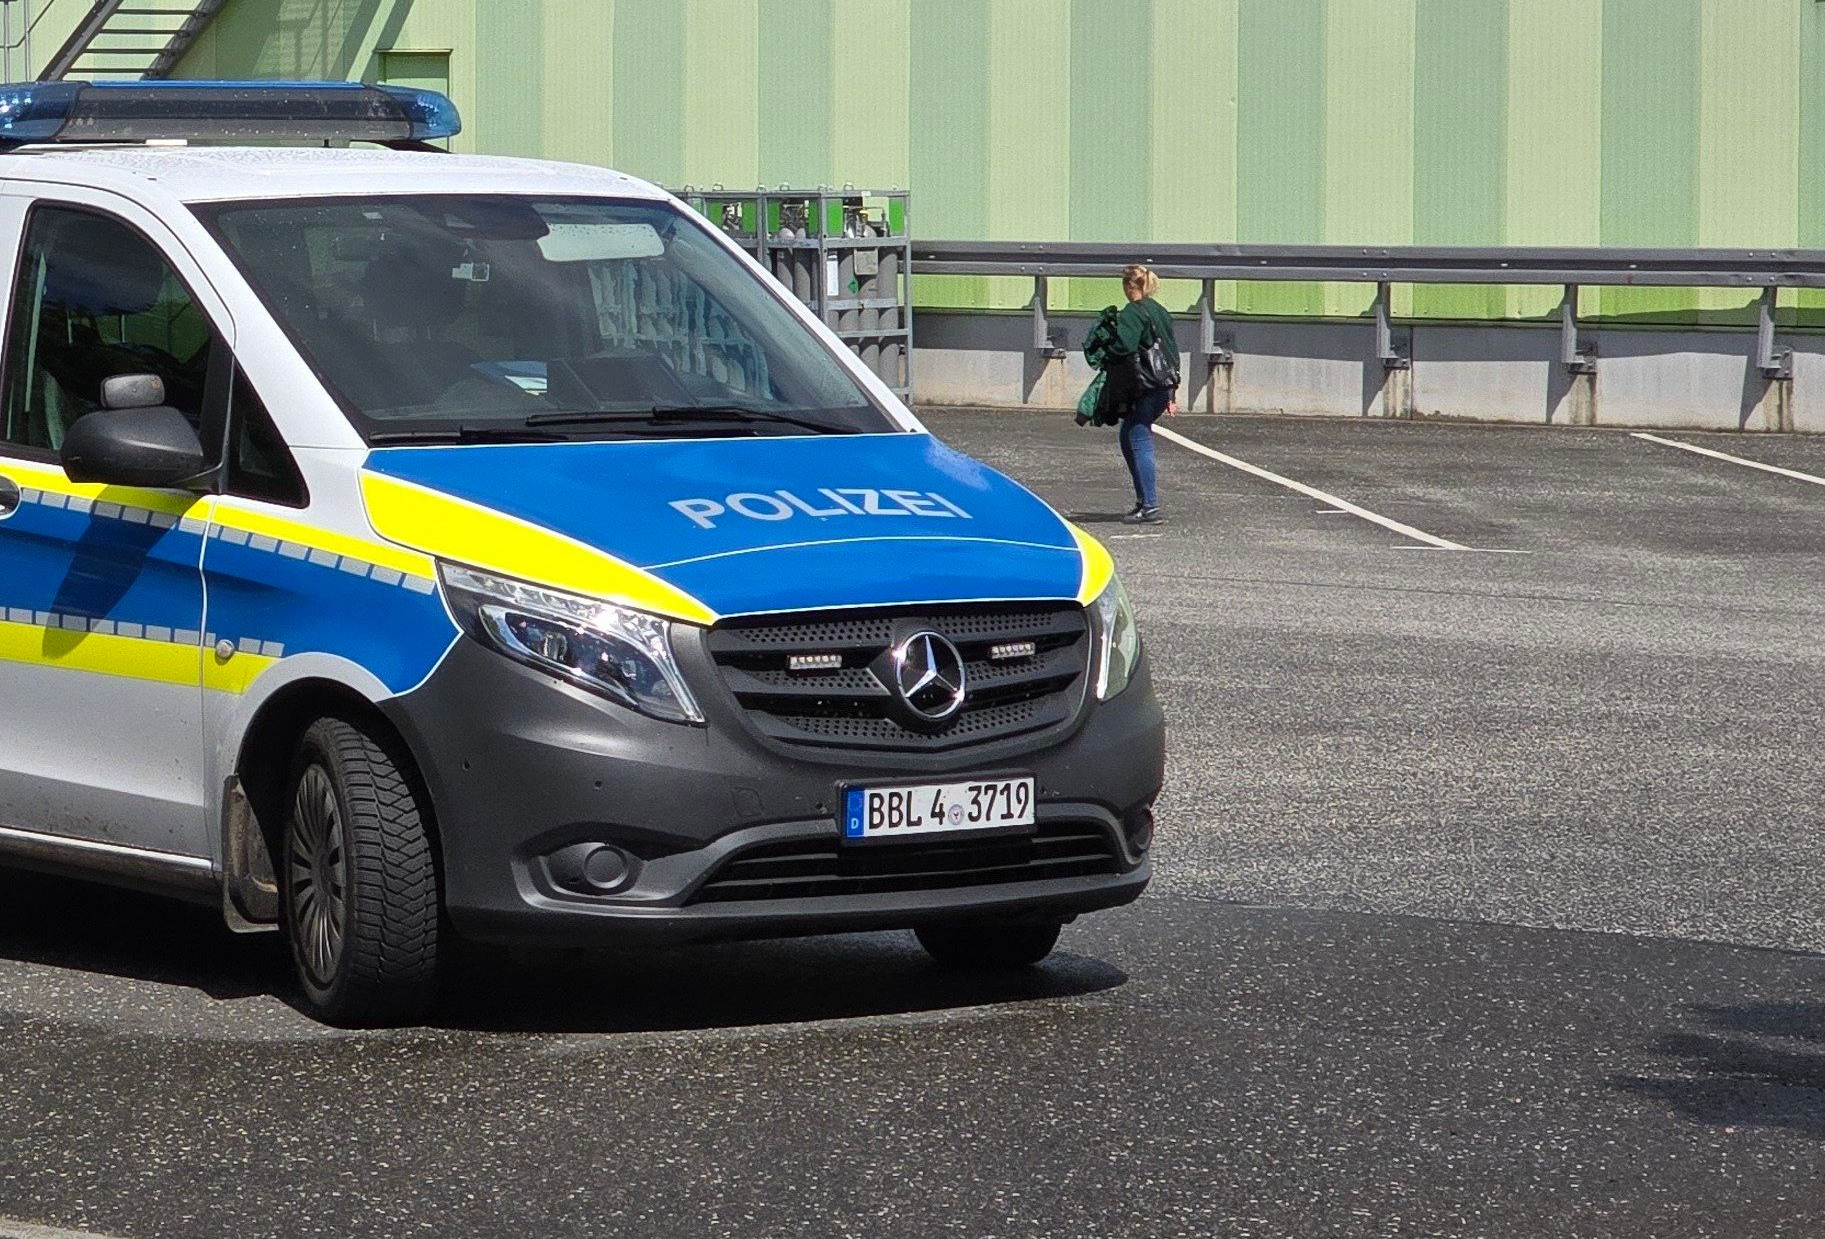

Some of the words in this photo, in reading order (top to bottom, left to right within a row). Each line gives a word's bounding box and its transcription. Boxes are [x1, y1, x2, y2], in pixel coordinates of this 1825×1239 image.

[667, 488, 973, 529] POLIZEI
[868, 790, 922, 830] BBL
[930, 788, 946, 825] 4
[967, 781, 1029, 823] 3719
